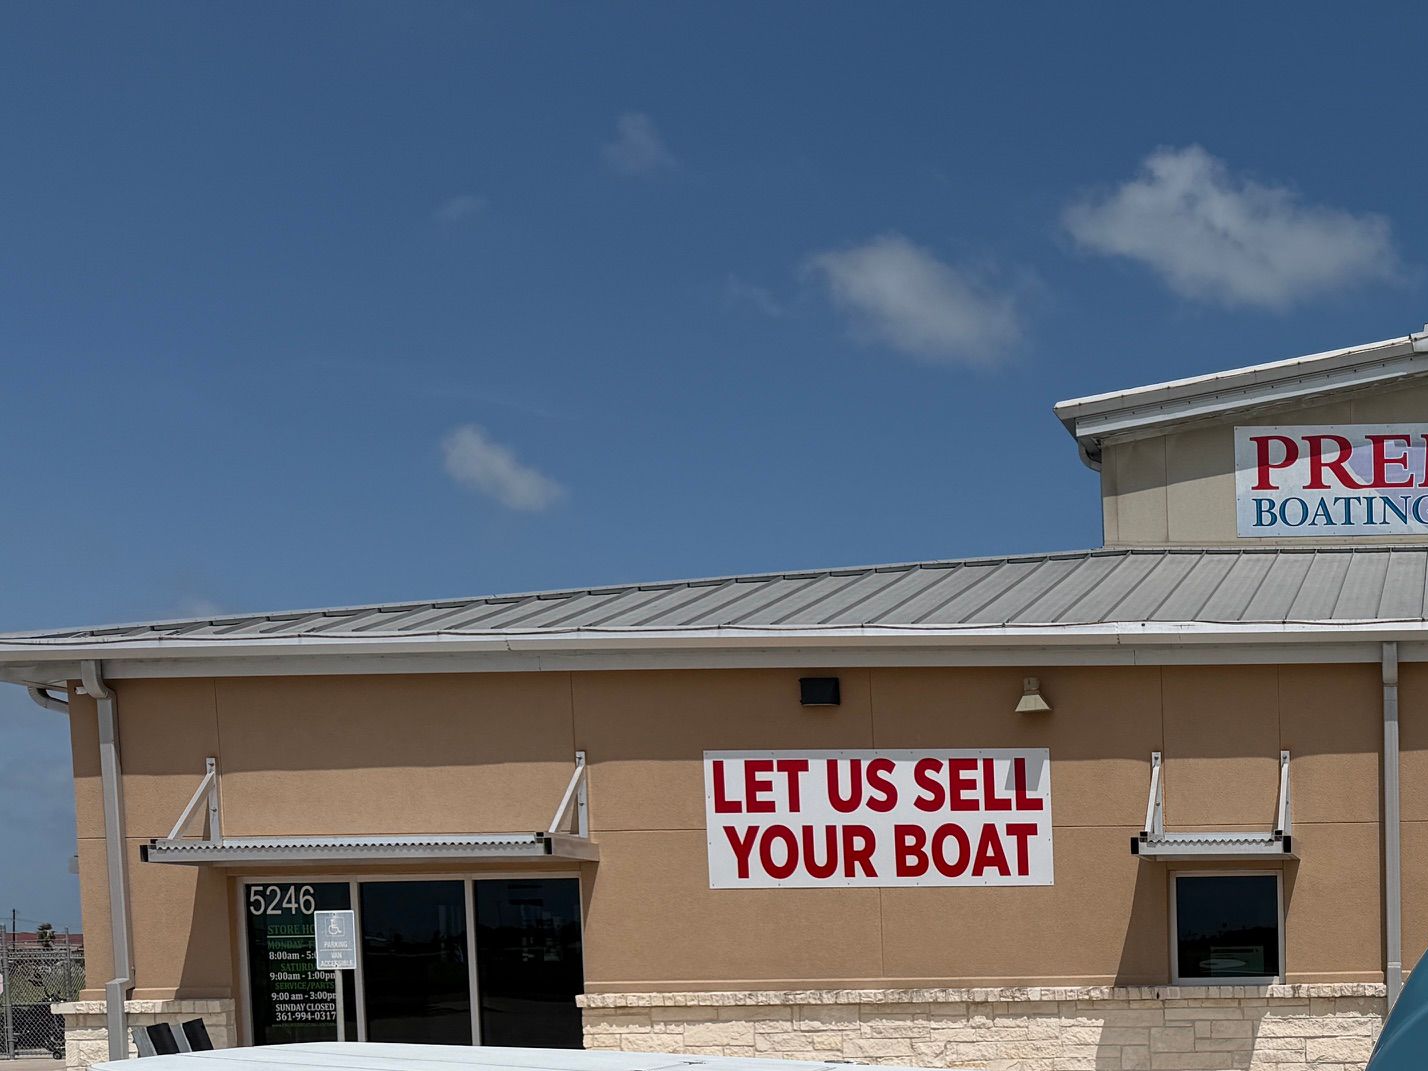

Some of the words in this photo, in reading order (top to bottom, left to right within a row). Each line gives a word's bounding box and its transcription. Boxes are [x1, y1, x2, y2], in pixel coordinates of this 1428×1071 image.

[713, 759, 809, 813] LET
[827, 758, 898, 813] US
[913, 757, 1044, 812] SELL
[722, 824, 879, 879] YOUR
[894, 823, 1038, 878] BOAT
[250, 885, 315, 916] 5246
[267, 924, 300, 935] STORE
[269, 951, 300, 960] 8:00am
[269, 971, 301, 981] 9:00am
[274, 981, 335, 991] SERVICE/PARTS
[271, 992, 290, 1001] 9:00
[275, 1003, 306, 1012] SUNDAY
[306, 1002, 335, 1011] CLOSED
[276, 1011, 337, 1021] 361-994-0317
